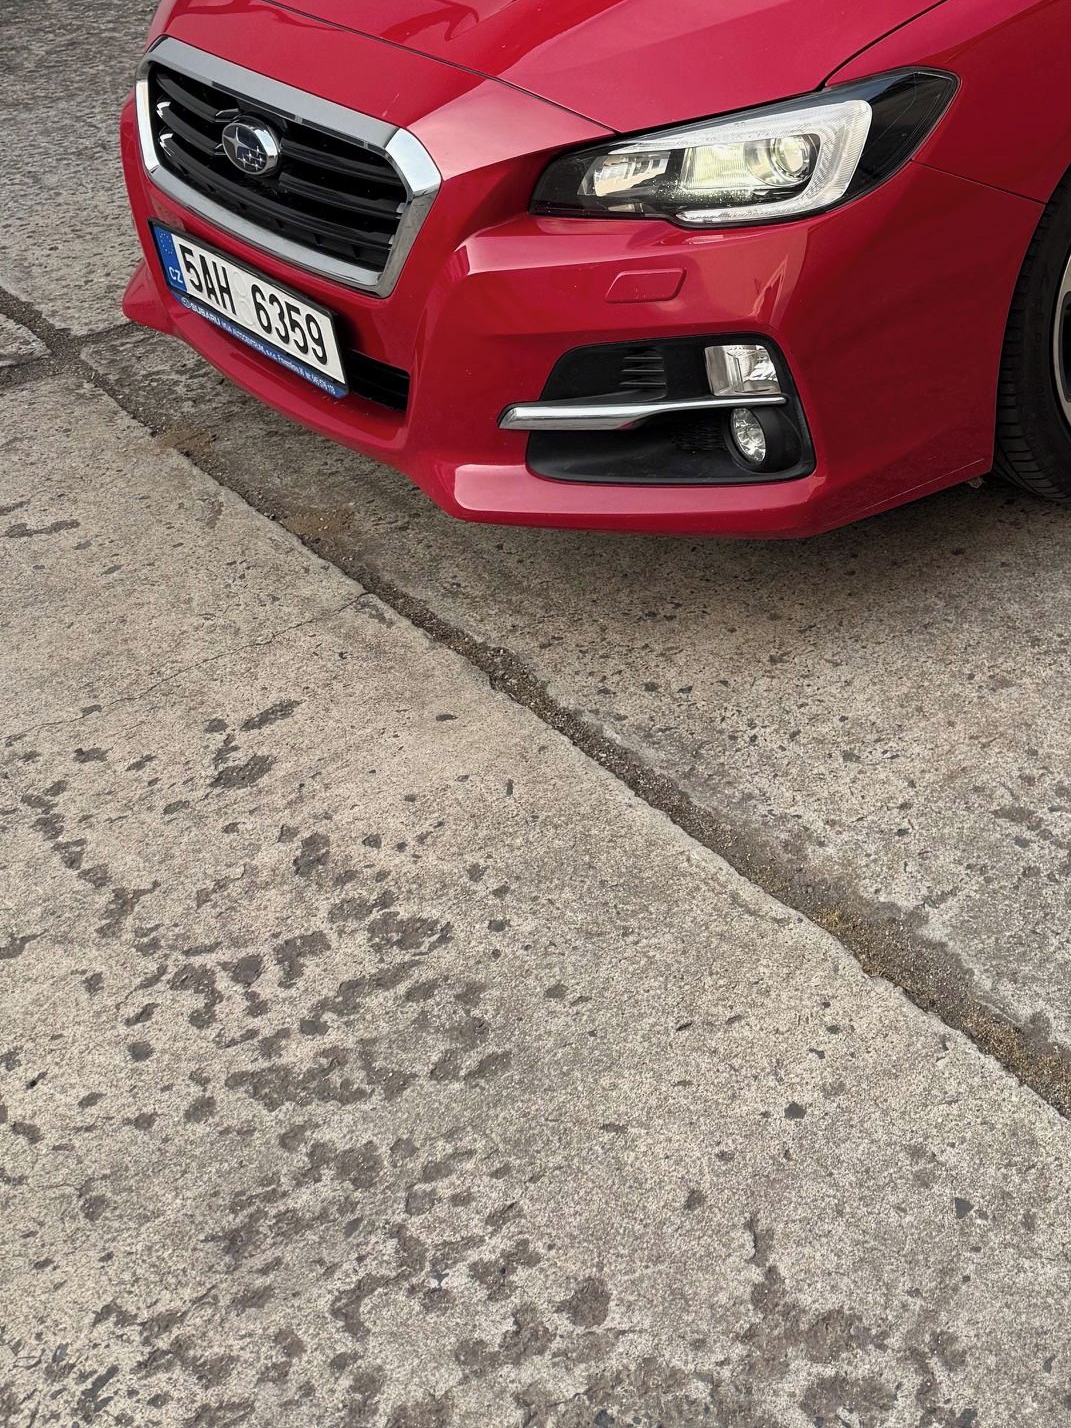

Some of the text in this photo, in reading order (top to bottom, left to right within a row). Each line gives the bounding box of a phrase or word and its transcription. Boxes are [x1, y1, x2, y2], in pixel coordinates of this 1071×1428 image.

[168, 266, 183, 284] CZ
[179, 243, 237, 315] 5AH
[251, 283, 328, 365] 6359
